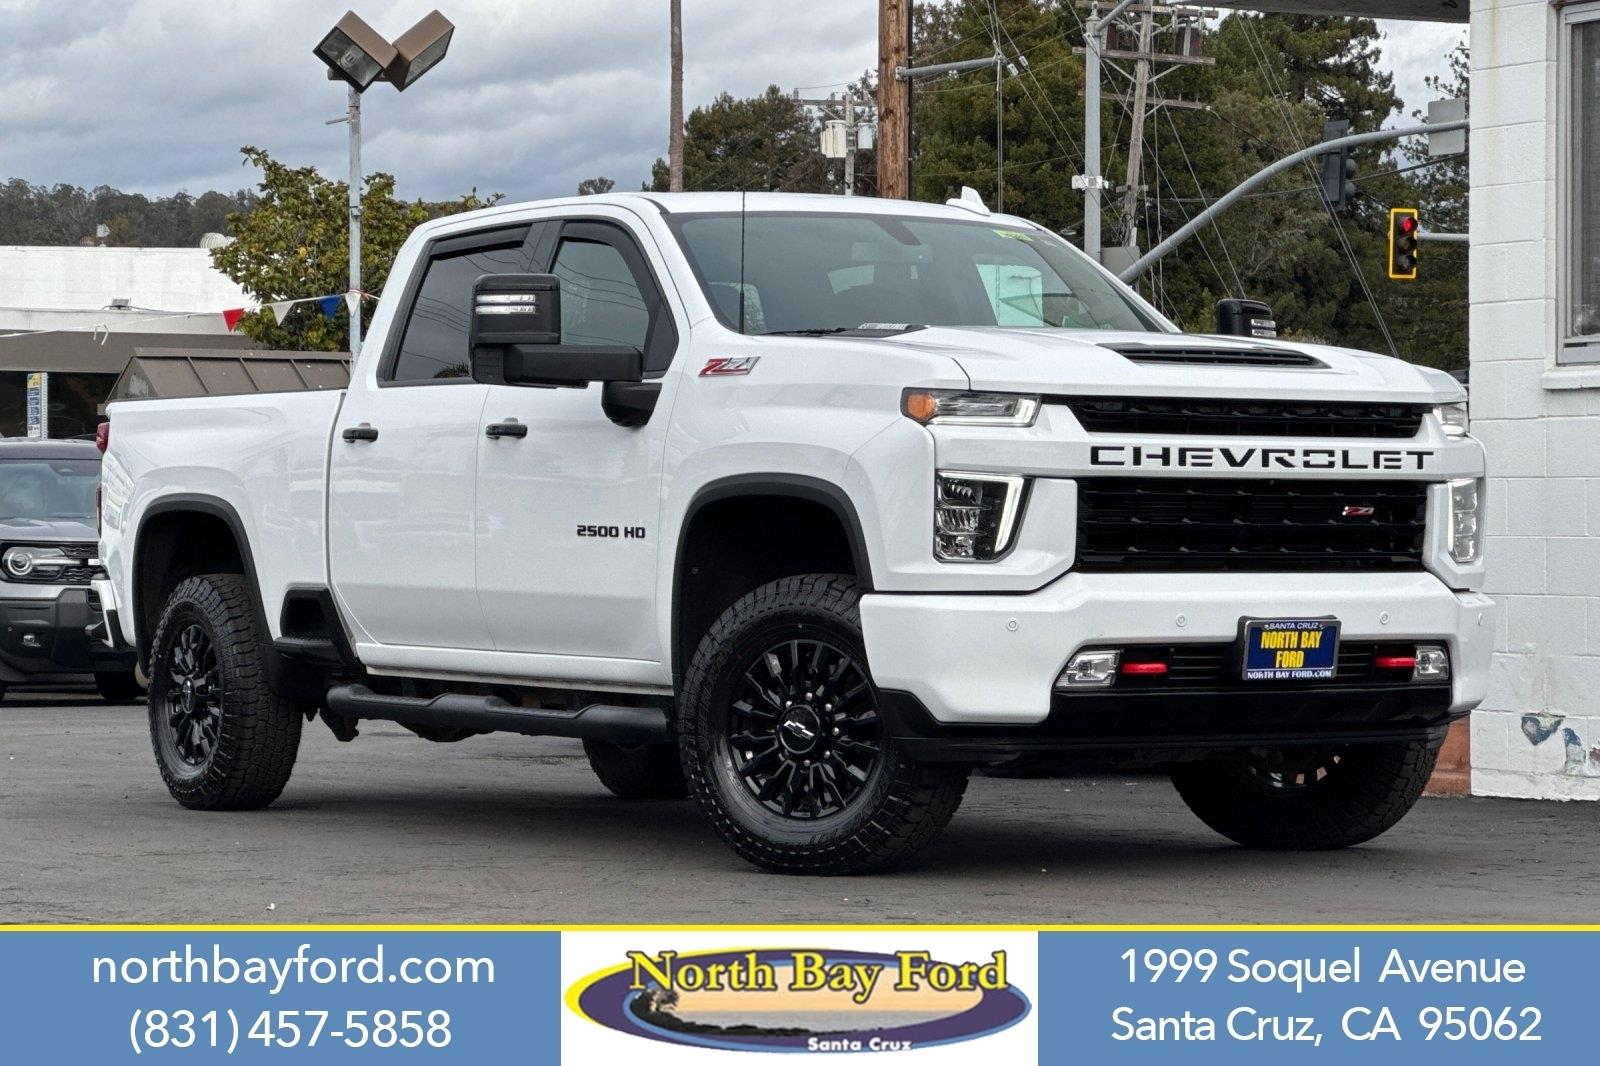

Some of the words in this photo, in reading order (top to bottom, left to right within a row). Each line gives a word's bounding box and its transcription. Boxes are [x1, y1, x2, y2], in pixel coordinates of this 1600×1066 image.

[1090, 445, 1435, 470] CHEVROLET
[576, 524, 620, 538] 2500
[624, 526, 646, 539] HD
[1260, 631, 1298, 648] NORTH
[1301, 631, 1323, 648] BAY
[1275, 650, 1305, 669] FORD
[1247, 670, 1274, 679] NORTH
[1275, 670, 1290, 679] BAY
